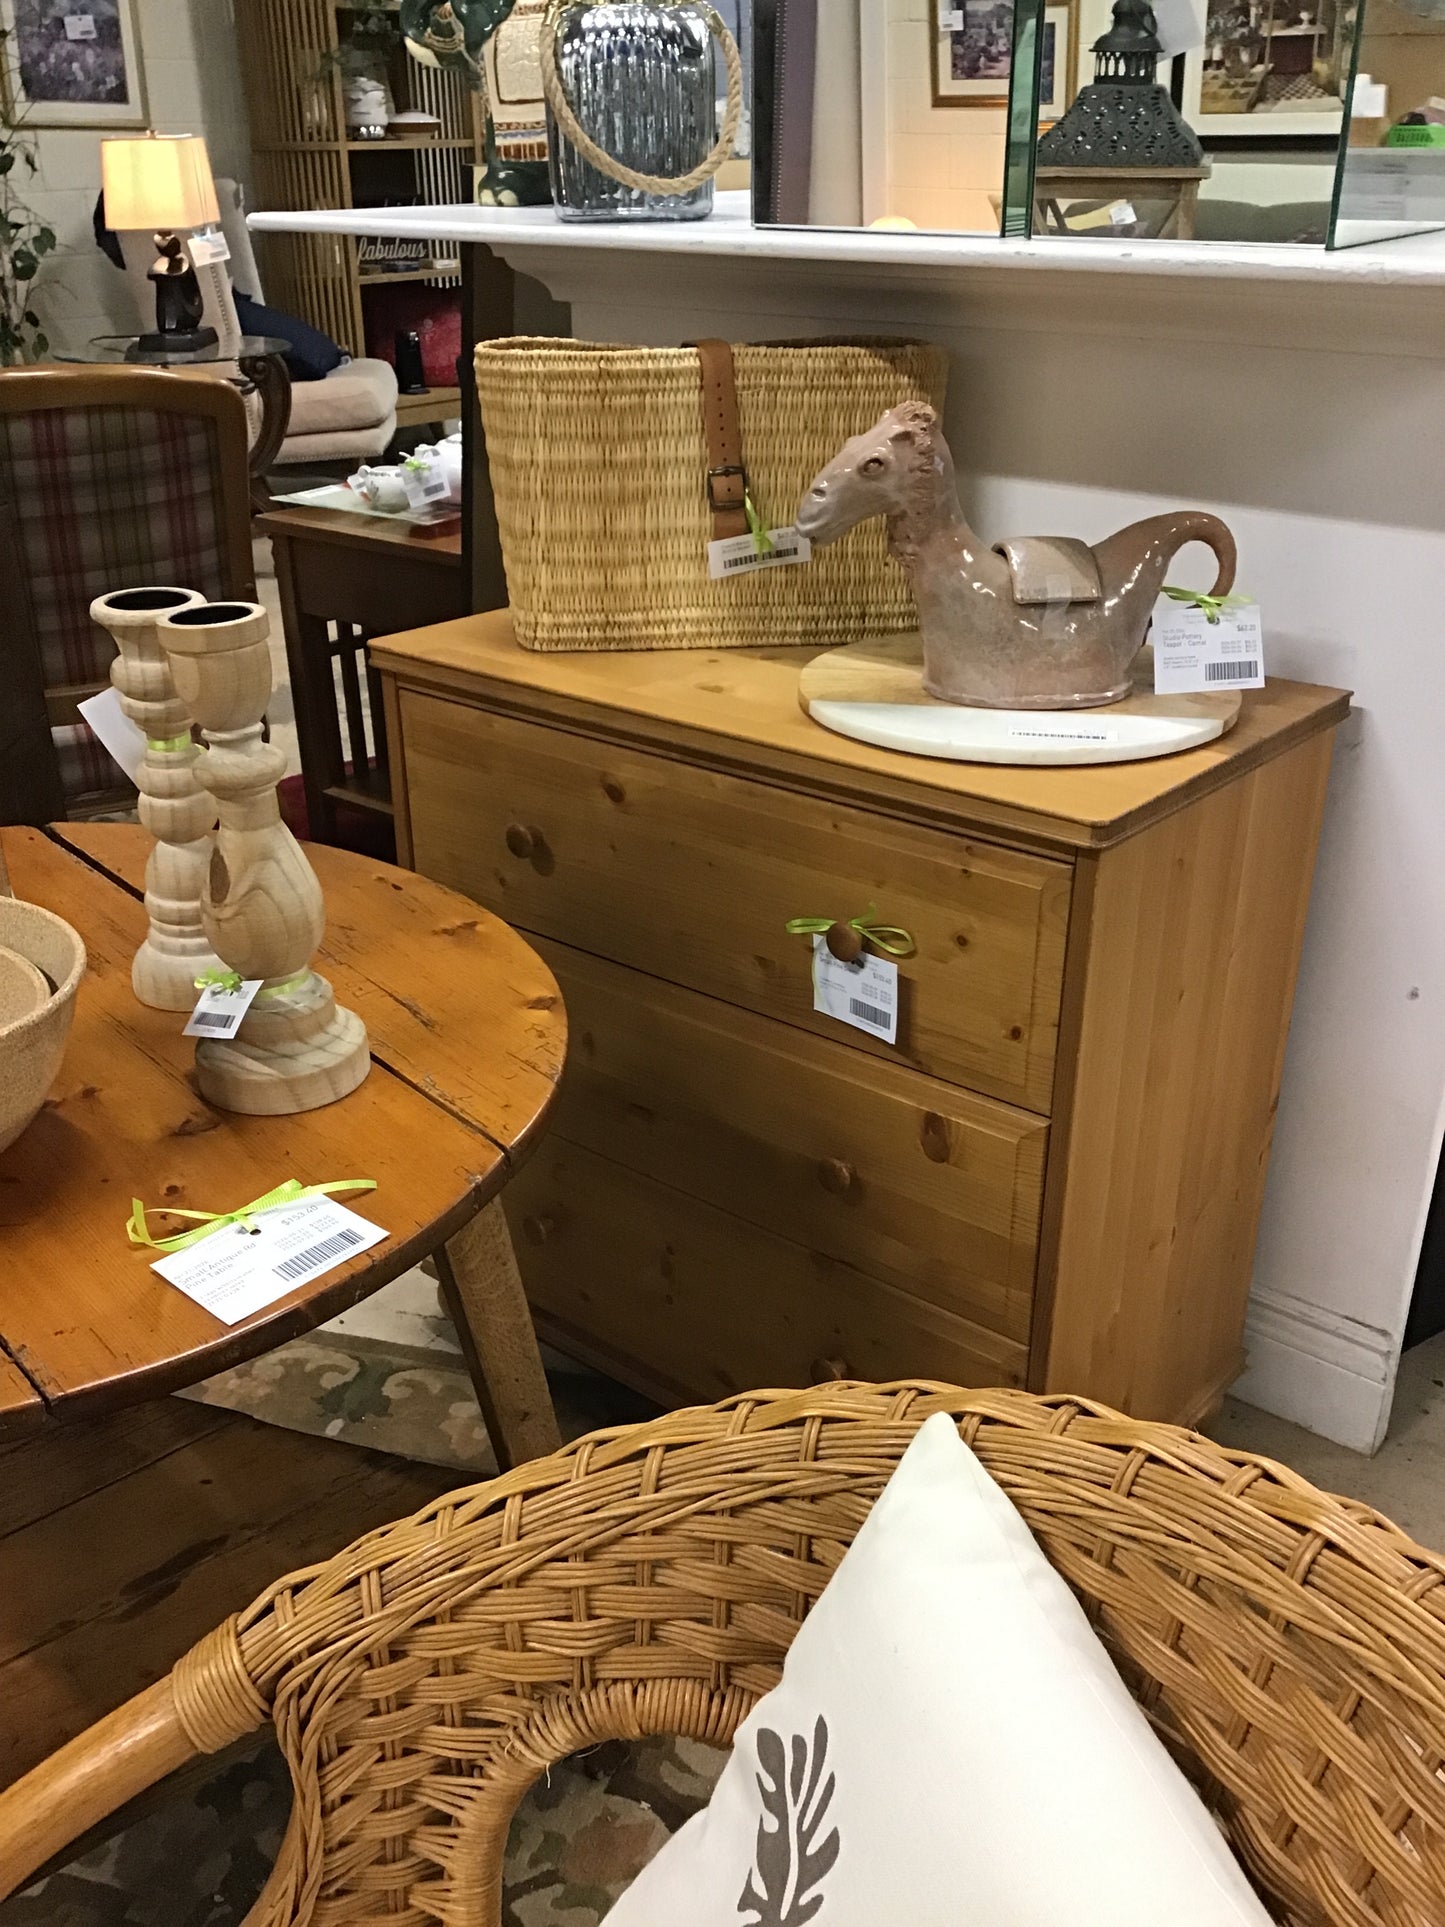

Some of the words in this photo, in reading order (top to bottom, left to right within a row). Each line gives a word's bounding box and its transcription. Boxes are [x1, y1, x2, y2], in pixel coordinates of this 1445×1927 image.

[356, 237, 427, 266] fabulous
[281, 1204, 319, 1226] $153.40
[178, 1267, 207, 1286] Small
[208, 1249, 244, 1271] Antique
[185, 1276, 207, 1290] Pine
[207, 1263, 234, 1279] Table
